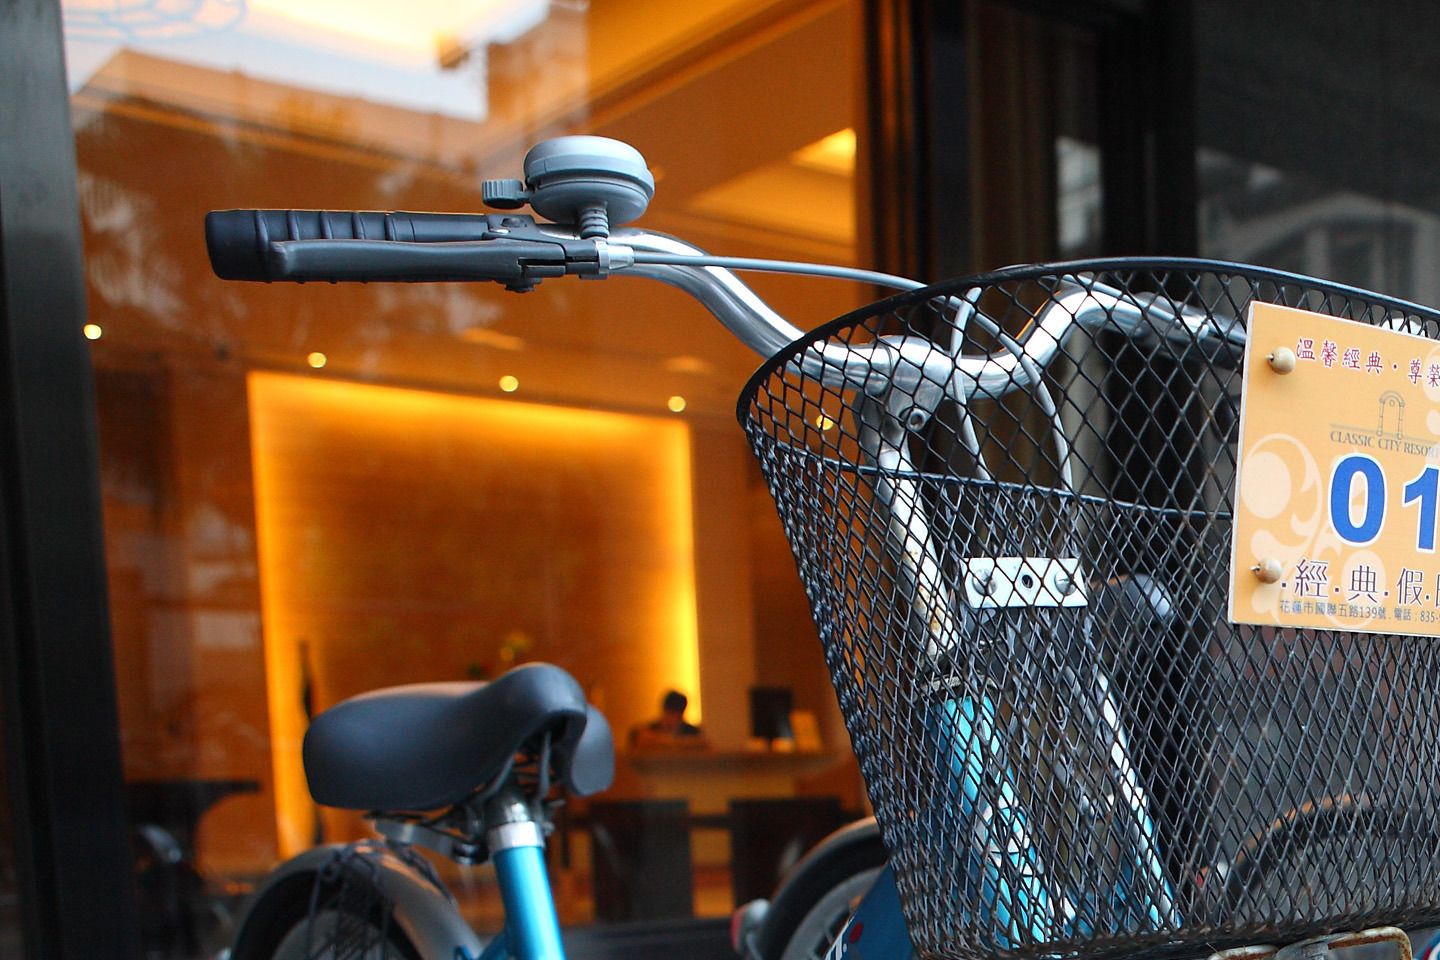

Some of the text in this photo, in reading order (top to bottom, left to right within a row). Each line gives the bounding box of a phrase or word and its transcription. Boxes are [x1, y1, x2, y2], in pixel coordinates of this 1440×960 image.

[1329, 430, 1375, 449] CLASSIC
[1378, 438, 1401, 453] CITY
[1329, 453, 1440, 552] 01
